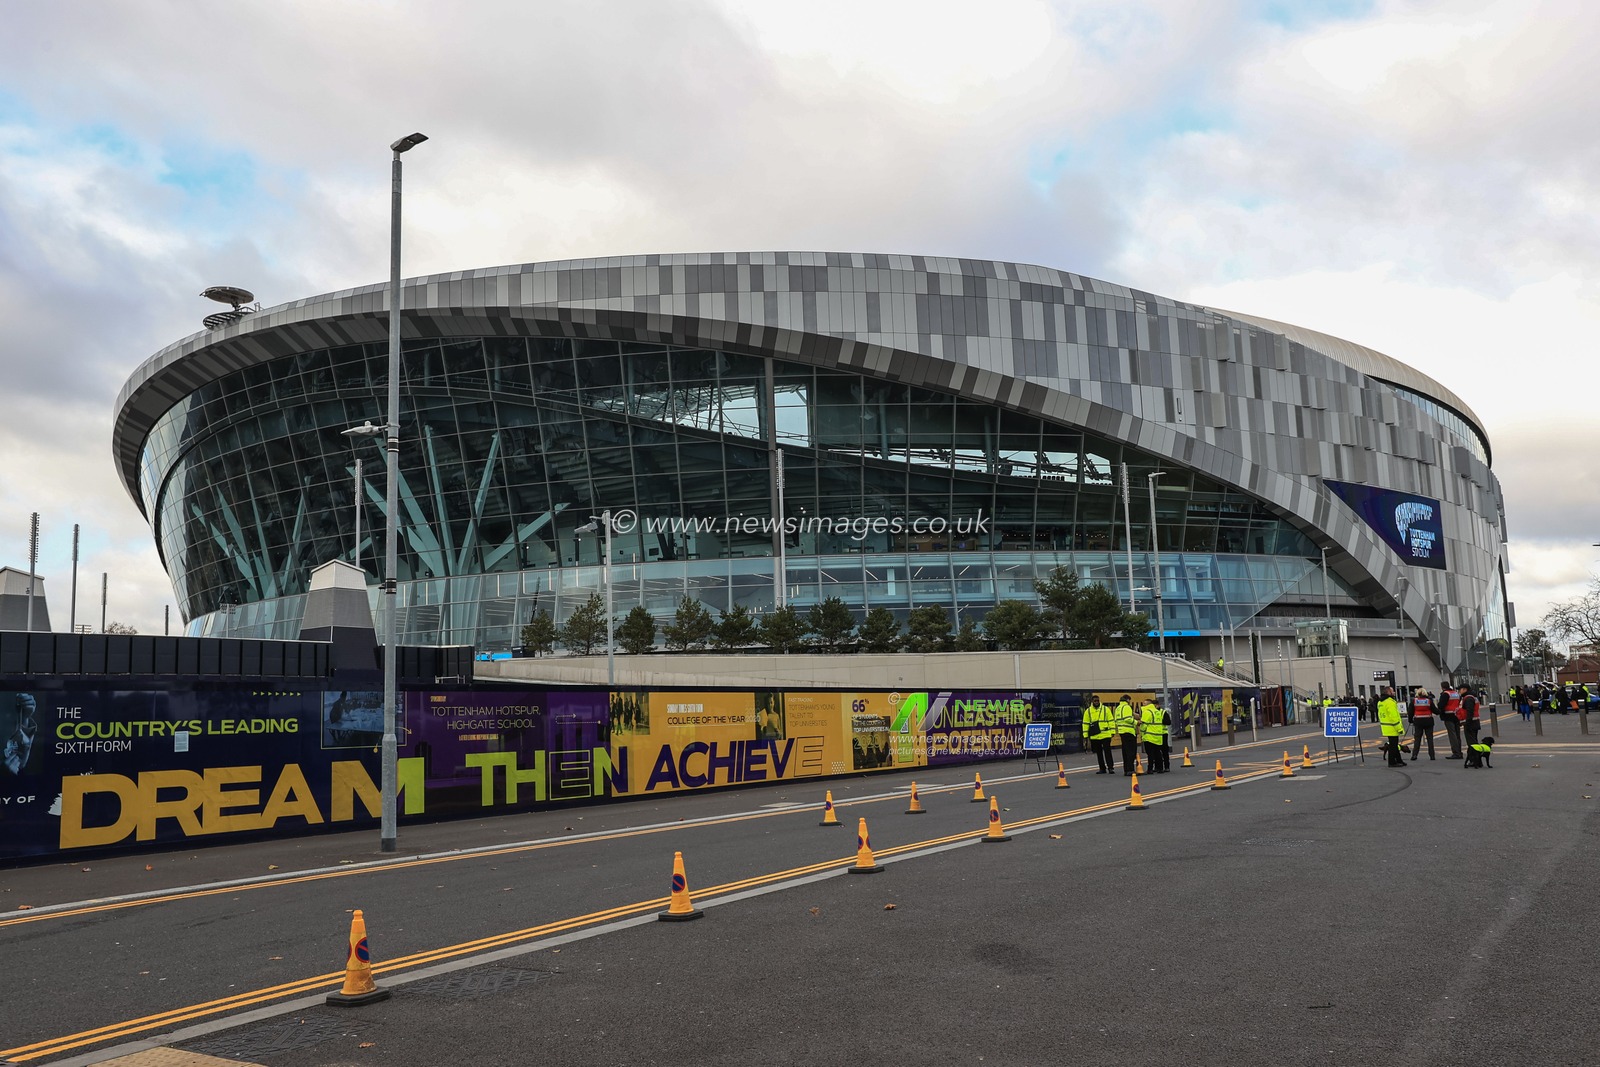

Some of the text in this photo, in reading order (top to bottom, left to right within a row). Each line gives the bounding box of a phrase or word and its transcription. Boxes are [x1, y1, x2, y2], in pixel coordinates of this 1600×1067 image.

[57, 707, 82, 718] THE
[431, 706, 494, 716] TOTTENHAM
[932, 704, 1033, 728] UNLEASHING
[208, 718, 298, 734] LEADING
[447, 718, 536, 730] HIGHGATE SCHOOL
[55, 740, 132, 754] SIXTH FORM
[933, 728, 1023, 756] POTENTIAL
[17, 796, 36, 804] OF
[60, 736, 824, 850] DREAM THEN ACHIEVE
